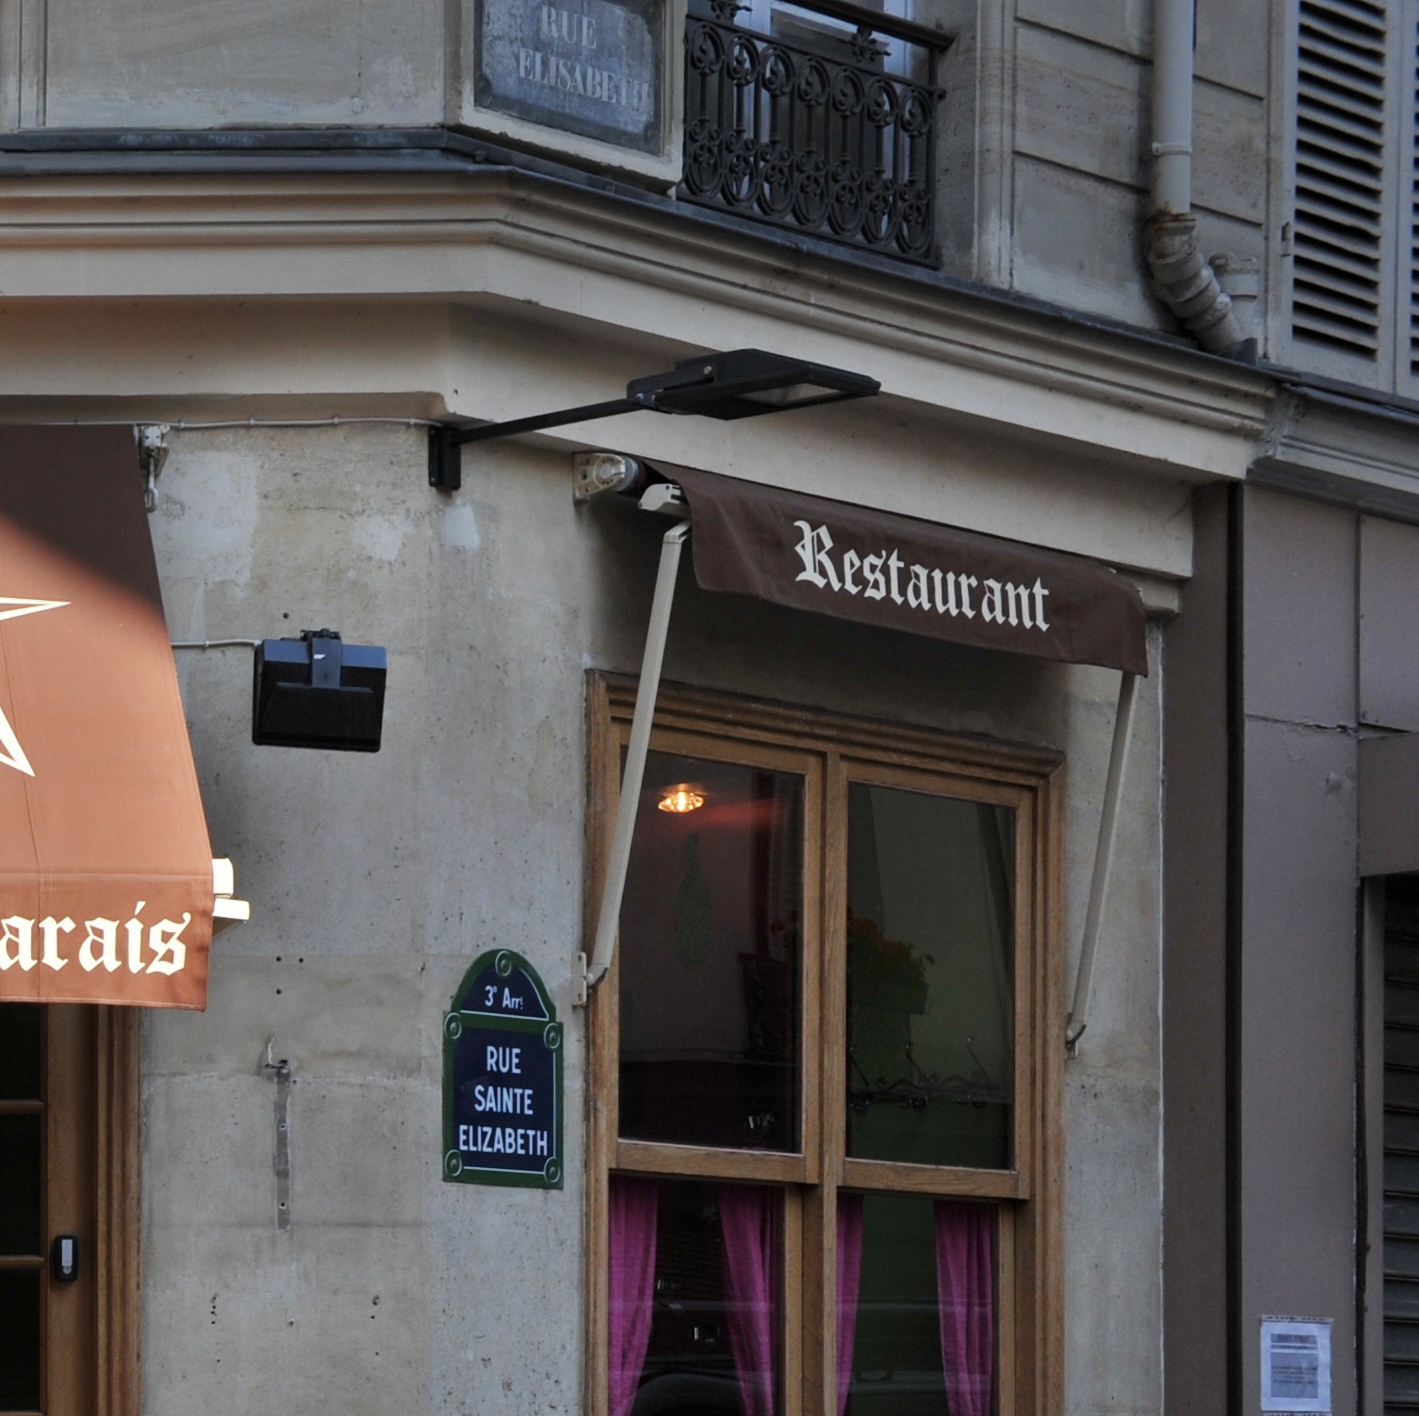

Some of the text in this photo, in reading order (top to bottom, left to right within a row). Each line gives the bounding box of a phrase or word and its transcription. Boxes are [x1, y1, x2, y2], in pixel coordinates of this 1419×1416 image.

[541, 5, 597, 49] RUE
[793, 520, 1050, 632] Restaurant
[486, 1045, 521, 1074] RUE
[474, 1084, 533, 1115] SAINTE
[459, 1124, 548, 1156] ELIZABETH
